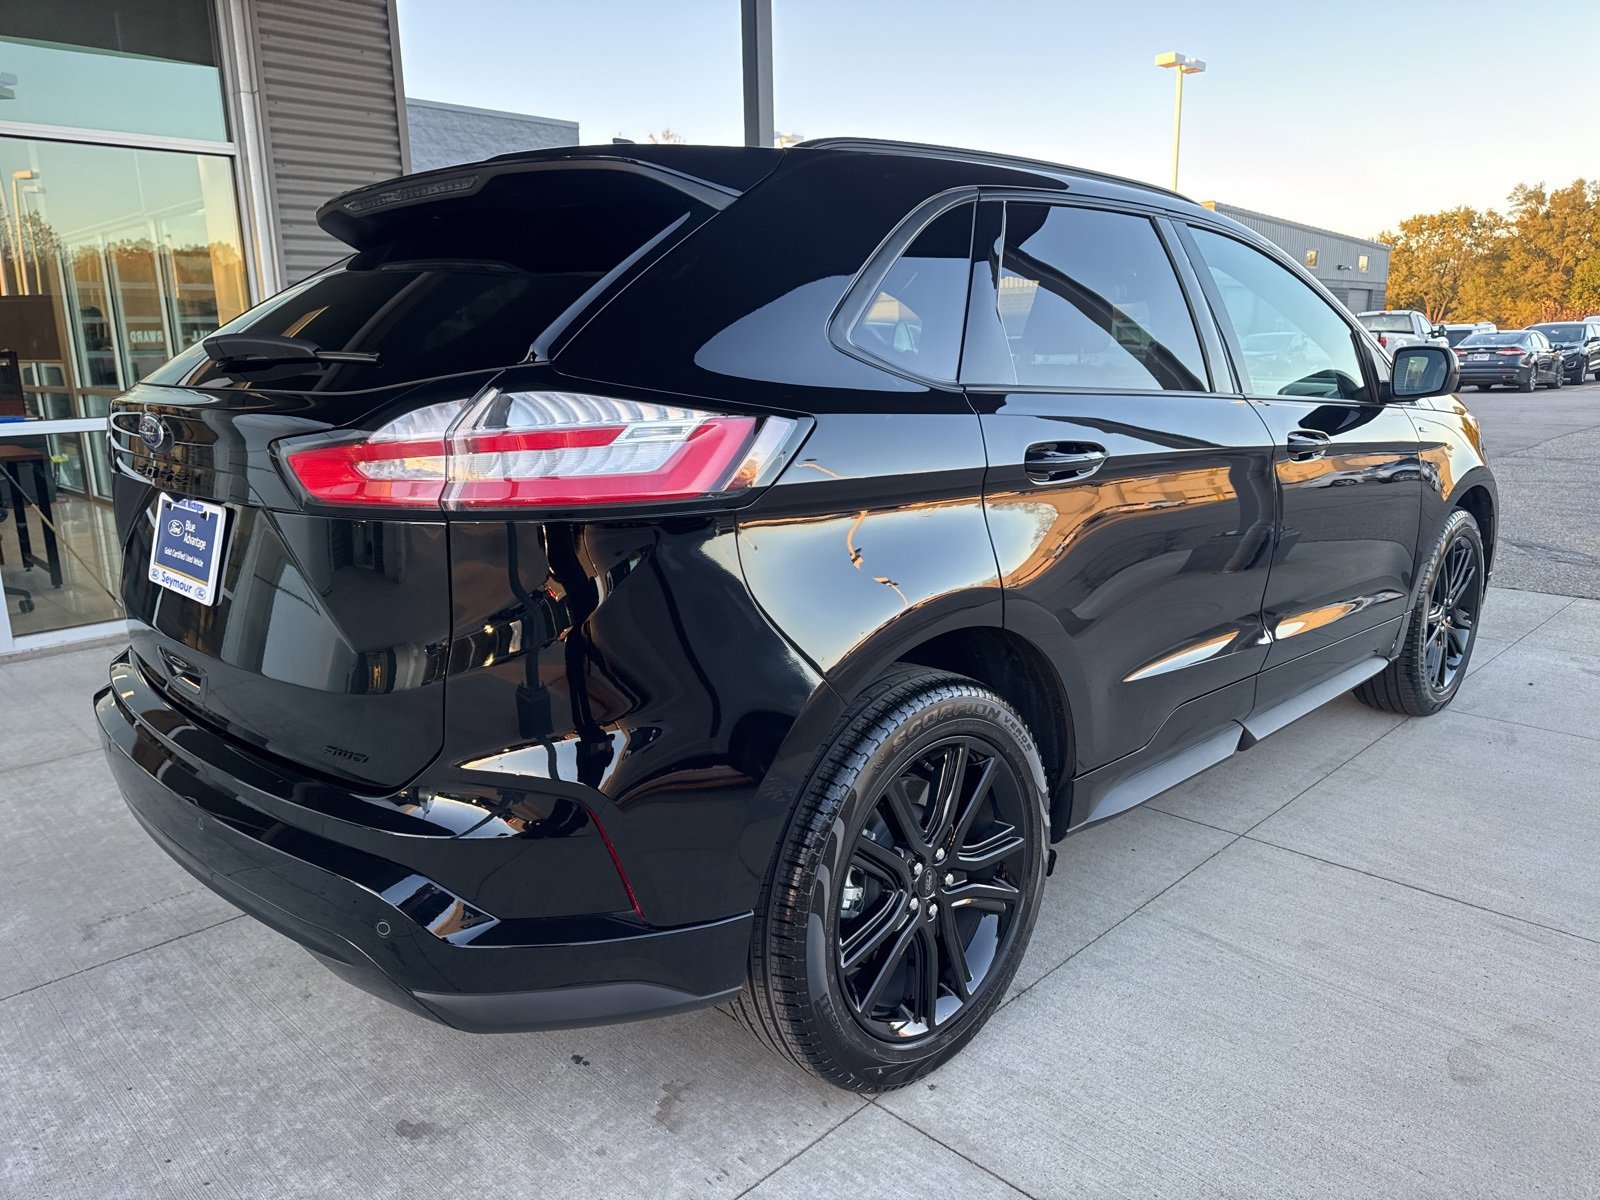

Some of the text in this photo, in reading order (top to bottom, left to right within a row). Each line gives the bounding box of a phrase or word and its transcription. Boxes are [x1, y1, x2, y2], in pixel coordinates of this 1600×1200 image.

[185, 520, 196, 532] Blue
[183, 533, 207, 550] Advantage
[161, 571, 193, 593] Seymour
[893, 703, 1034, 752] SCORPION VERDE
